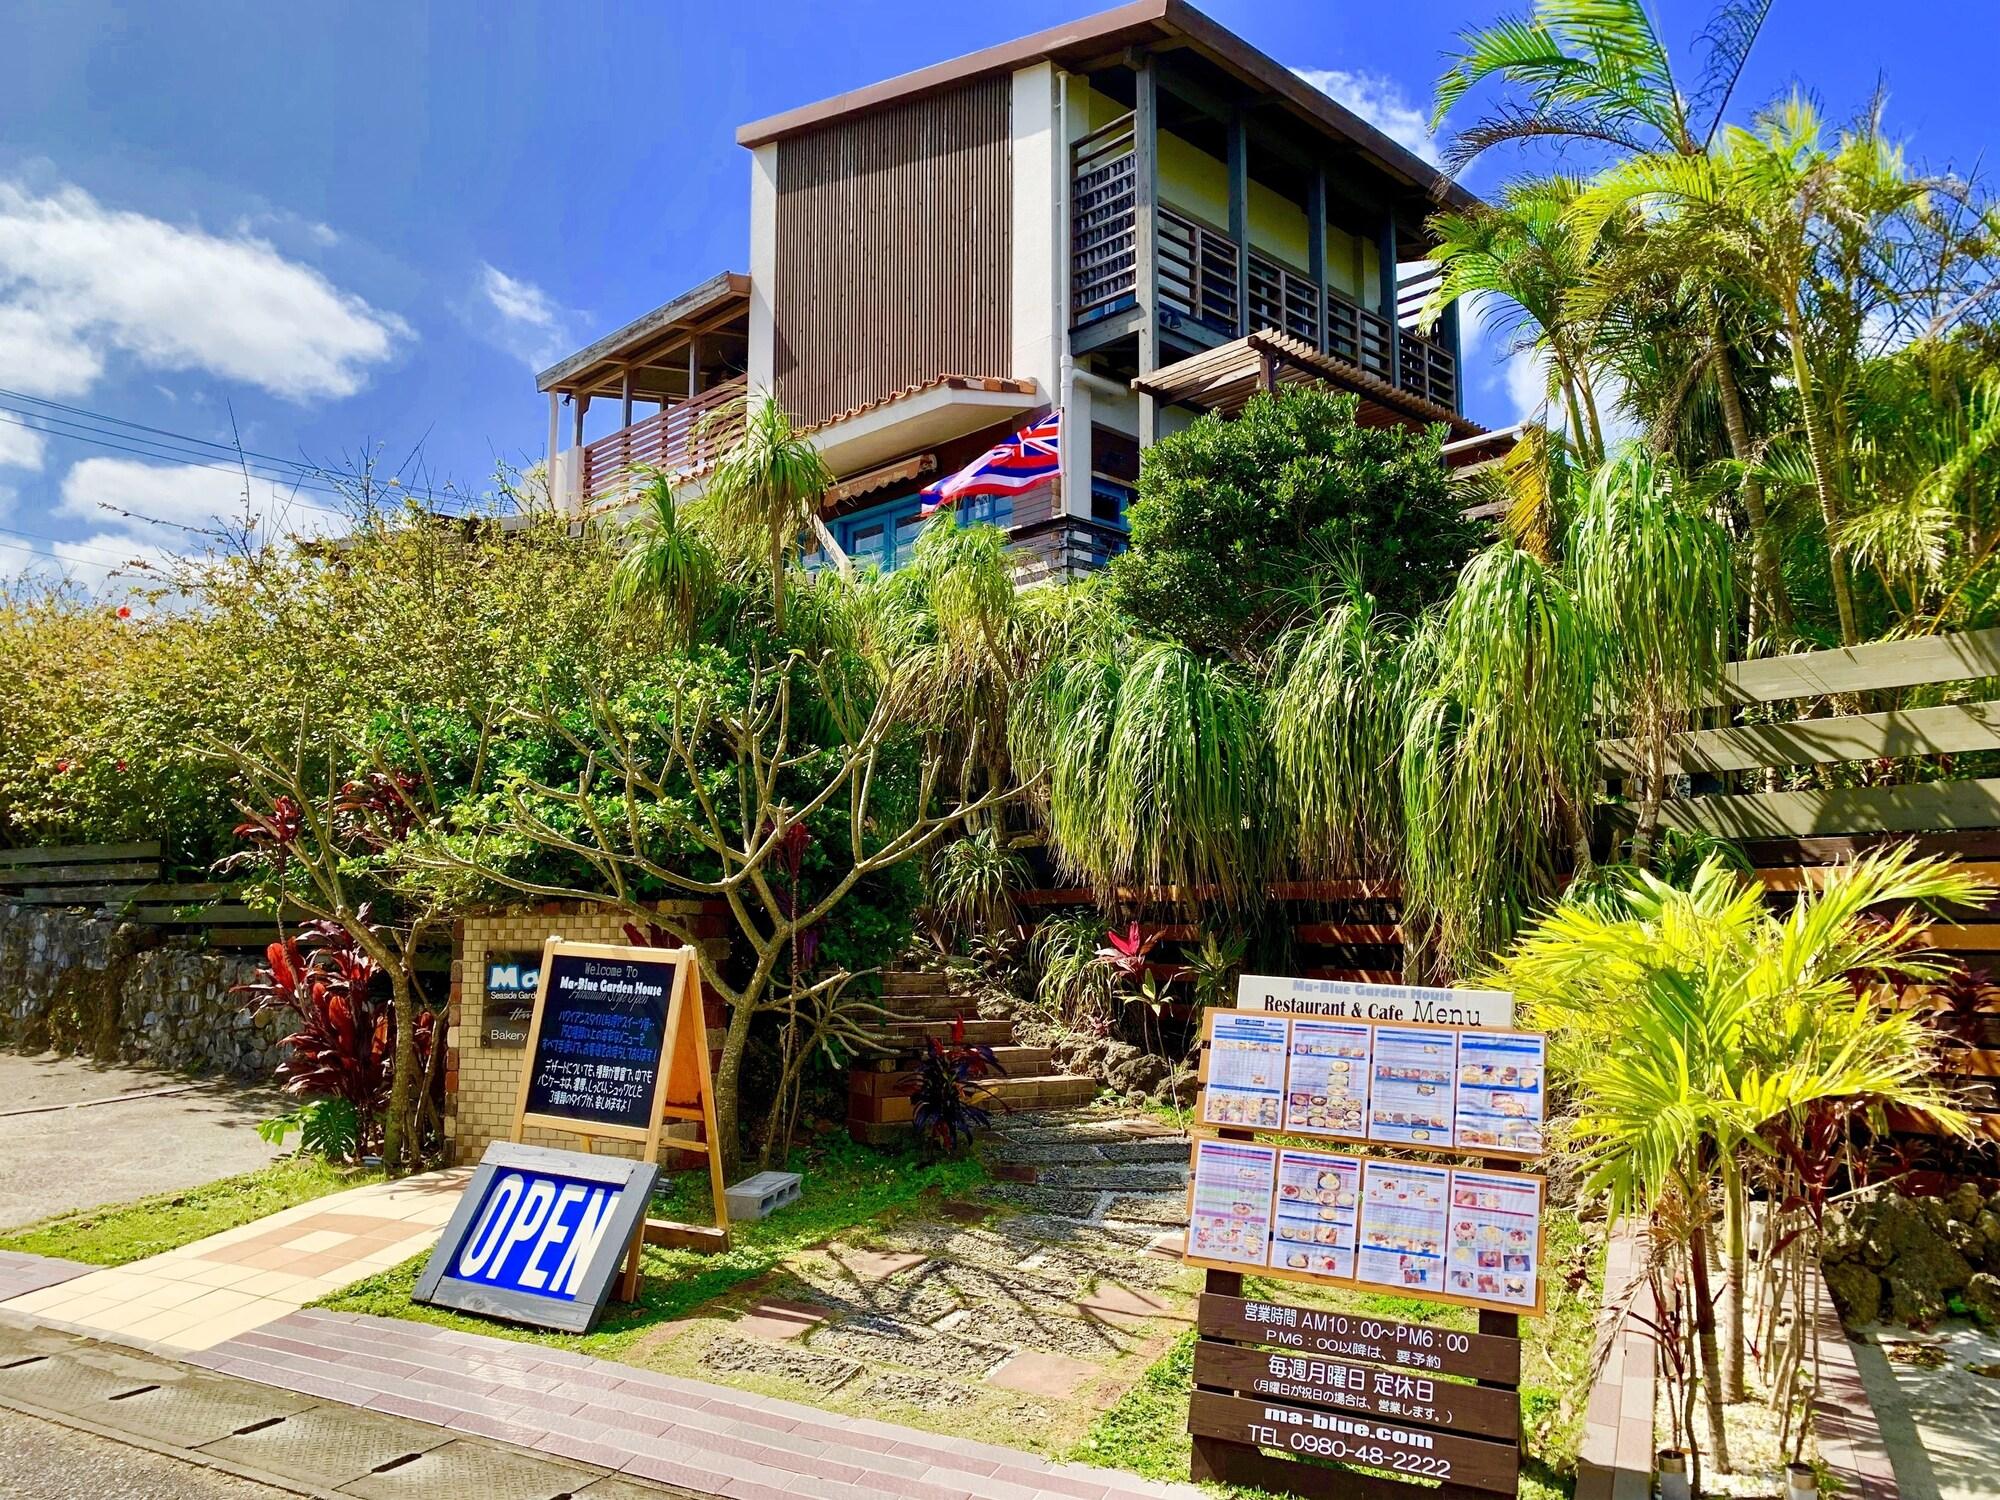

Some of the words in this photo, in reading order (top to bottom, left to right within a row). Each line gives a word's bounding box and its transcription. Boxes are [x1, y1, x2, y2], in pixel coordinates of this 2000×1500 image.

[585, 962, 622, 977] Welcome
[626, 965, 638, 978] To
[490, 991, 517, 1000] Seaside
[560, 976, 599, 992] Ma-Blue
[600, 979, 634, 994] Garden
[634, 981, 662, 997] House
[1293, 979, 1350, 995] Ma-Blue
[1355, 985, 1406, 999] Garden
[1411, 989, 1453, 1002] House
[1264, 995, 1346, 1017] Restaurant
[1351, 1002, 1362, 1019] &
[1368, 1003, 1404, 1021] Cafe
[1412, 1001, 1482, 1027] Menu
[491, 1029, 527, 1041] Bakery
[459, 1173, 620, 1295] OPEN
[1245, 1302, 1297, 1328] 営業時間
[1268, 1354, 1365, 1392] 毎週月曜日
[1373, 1373, 1434, 1402] 定休日
[1264, 1407, 1433, 1450] ma-blue.com
[1248, 1424, 1284, 1448] TEL
[1290, 1433, 1451, 1479] 0980-48-2222
